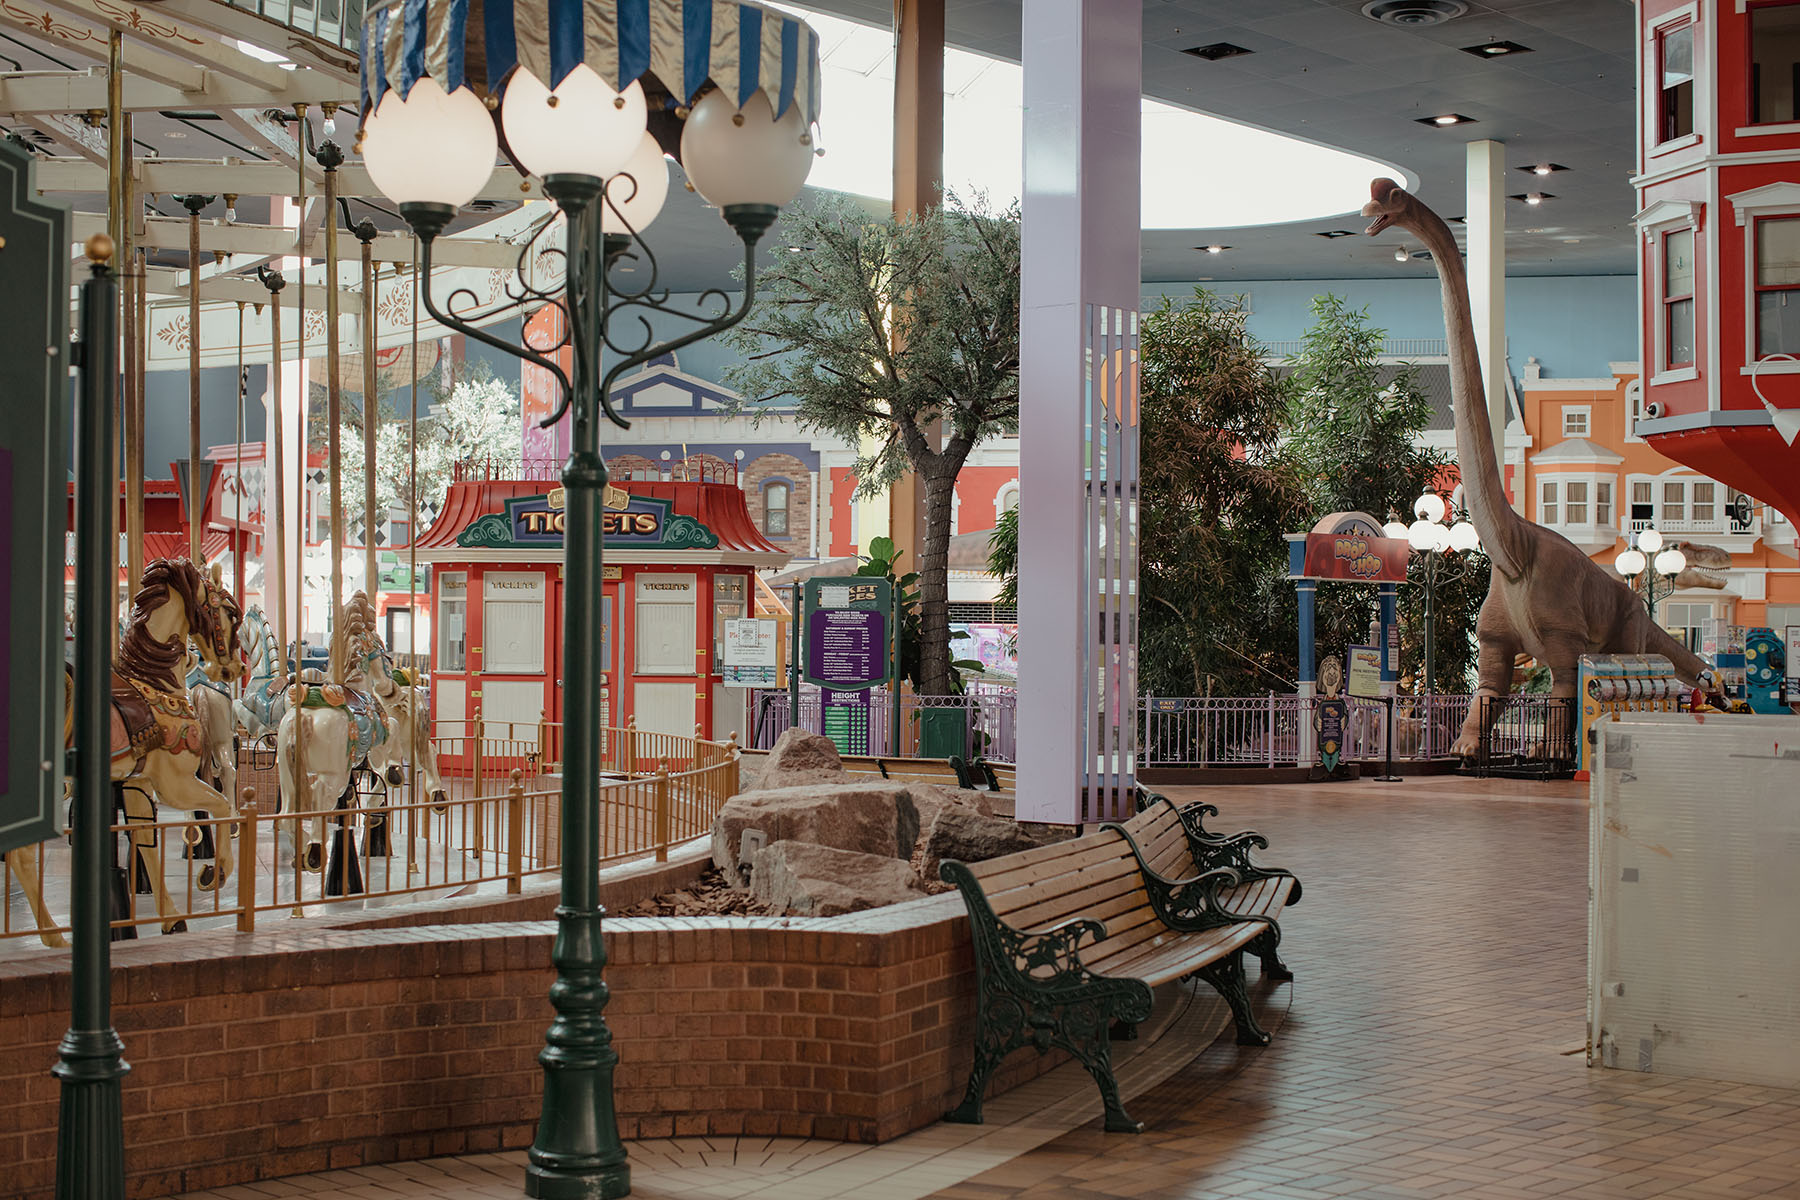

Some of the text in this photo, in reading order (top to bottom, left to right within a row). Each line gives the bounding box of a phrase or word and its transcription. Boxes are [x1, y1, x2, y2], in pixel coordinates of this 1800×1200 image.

[1335, 538, 1368, 560] DROP
[1356, 554, 1382, 578] HOP
[643, 583, 690, 591] TICKETS
